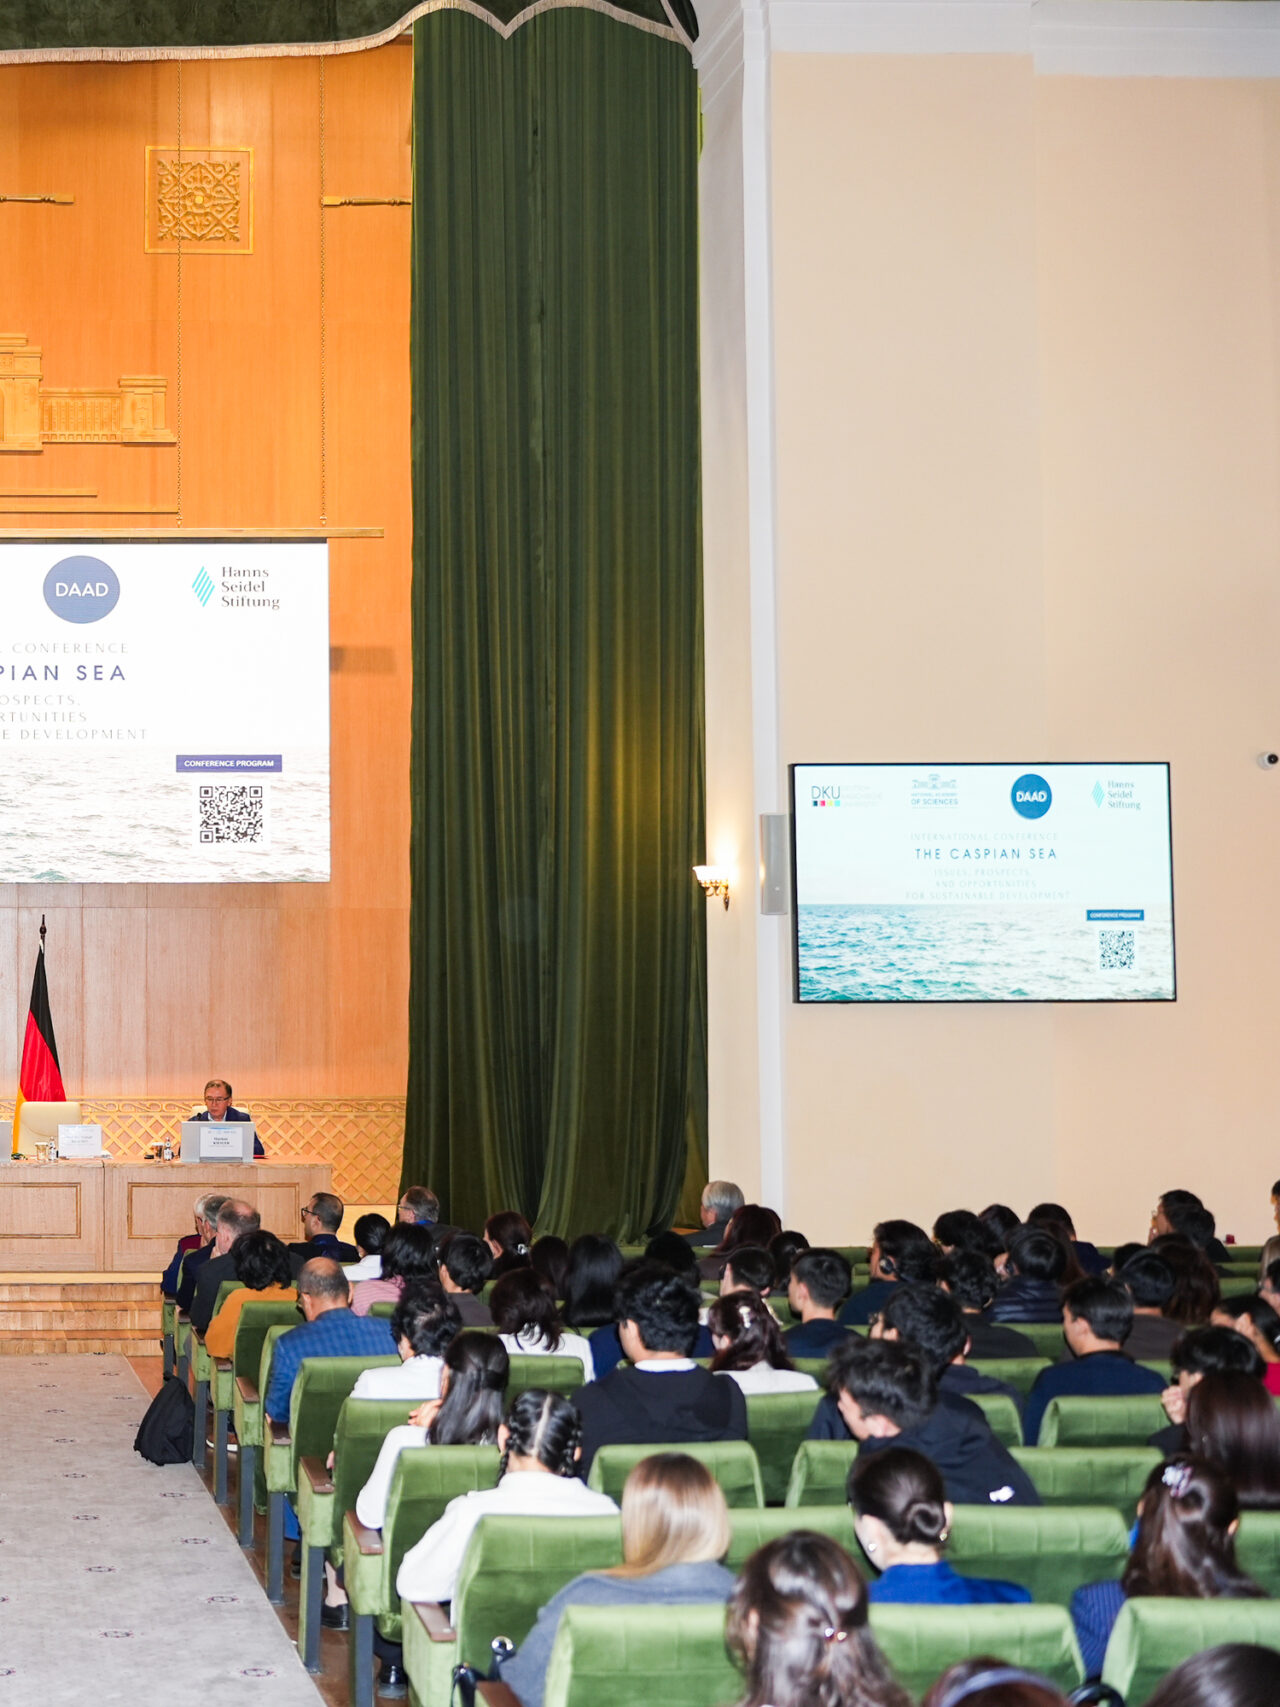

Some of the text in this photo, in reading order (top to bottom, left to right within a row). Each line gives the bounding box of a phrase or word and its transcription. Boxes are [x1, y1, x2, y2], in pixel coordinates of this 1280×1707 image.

[221, 566, 269, 578] Hanns
[55, 582, 109, 597] DAAD
[221, 581, 265, 593] Seidel
[221, 595, 280, 610] Stiftung
[12, 643, 128, 654] CONFERENCE
[76, 665, 126, 681] SEA
[20, 729, 147, 740] DEVELOPMENT
[1108, 780, 1135, 789] Hanns
[811, 785, 841, 799] DKU
[1016, 791, 1047, 803] DAAD
[1108, 790, 1133, 799] Seidel
[1108, 800, 1142, 811] Stiftung
[915, 848, 1057, 860] THE CASPIAN SEA
